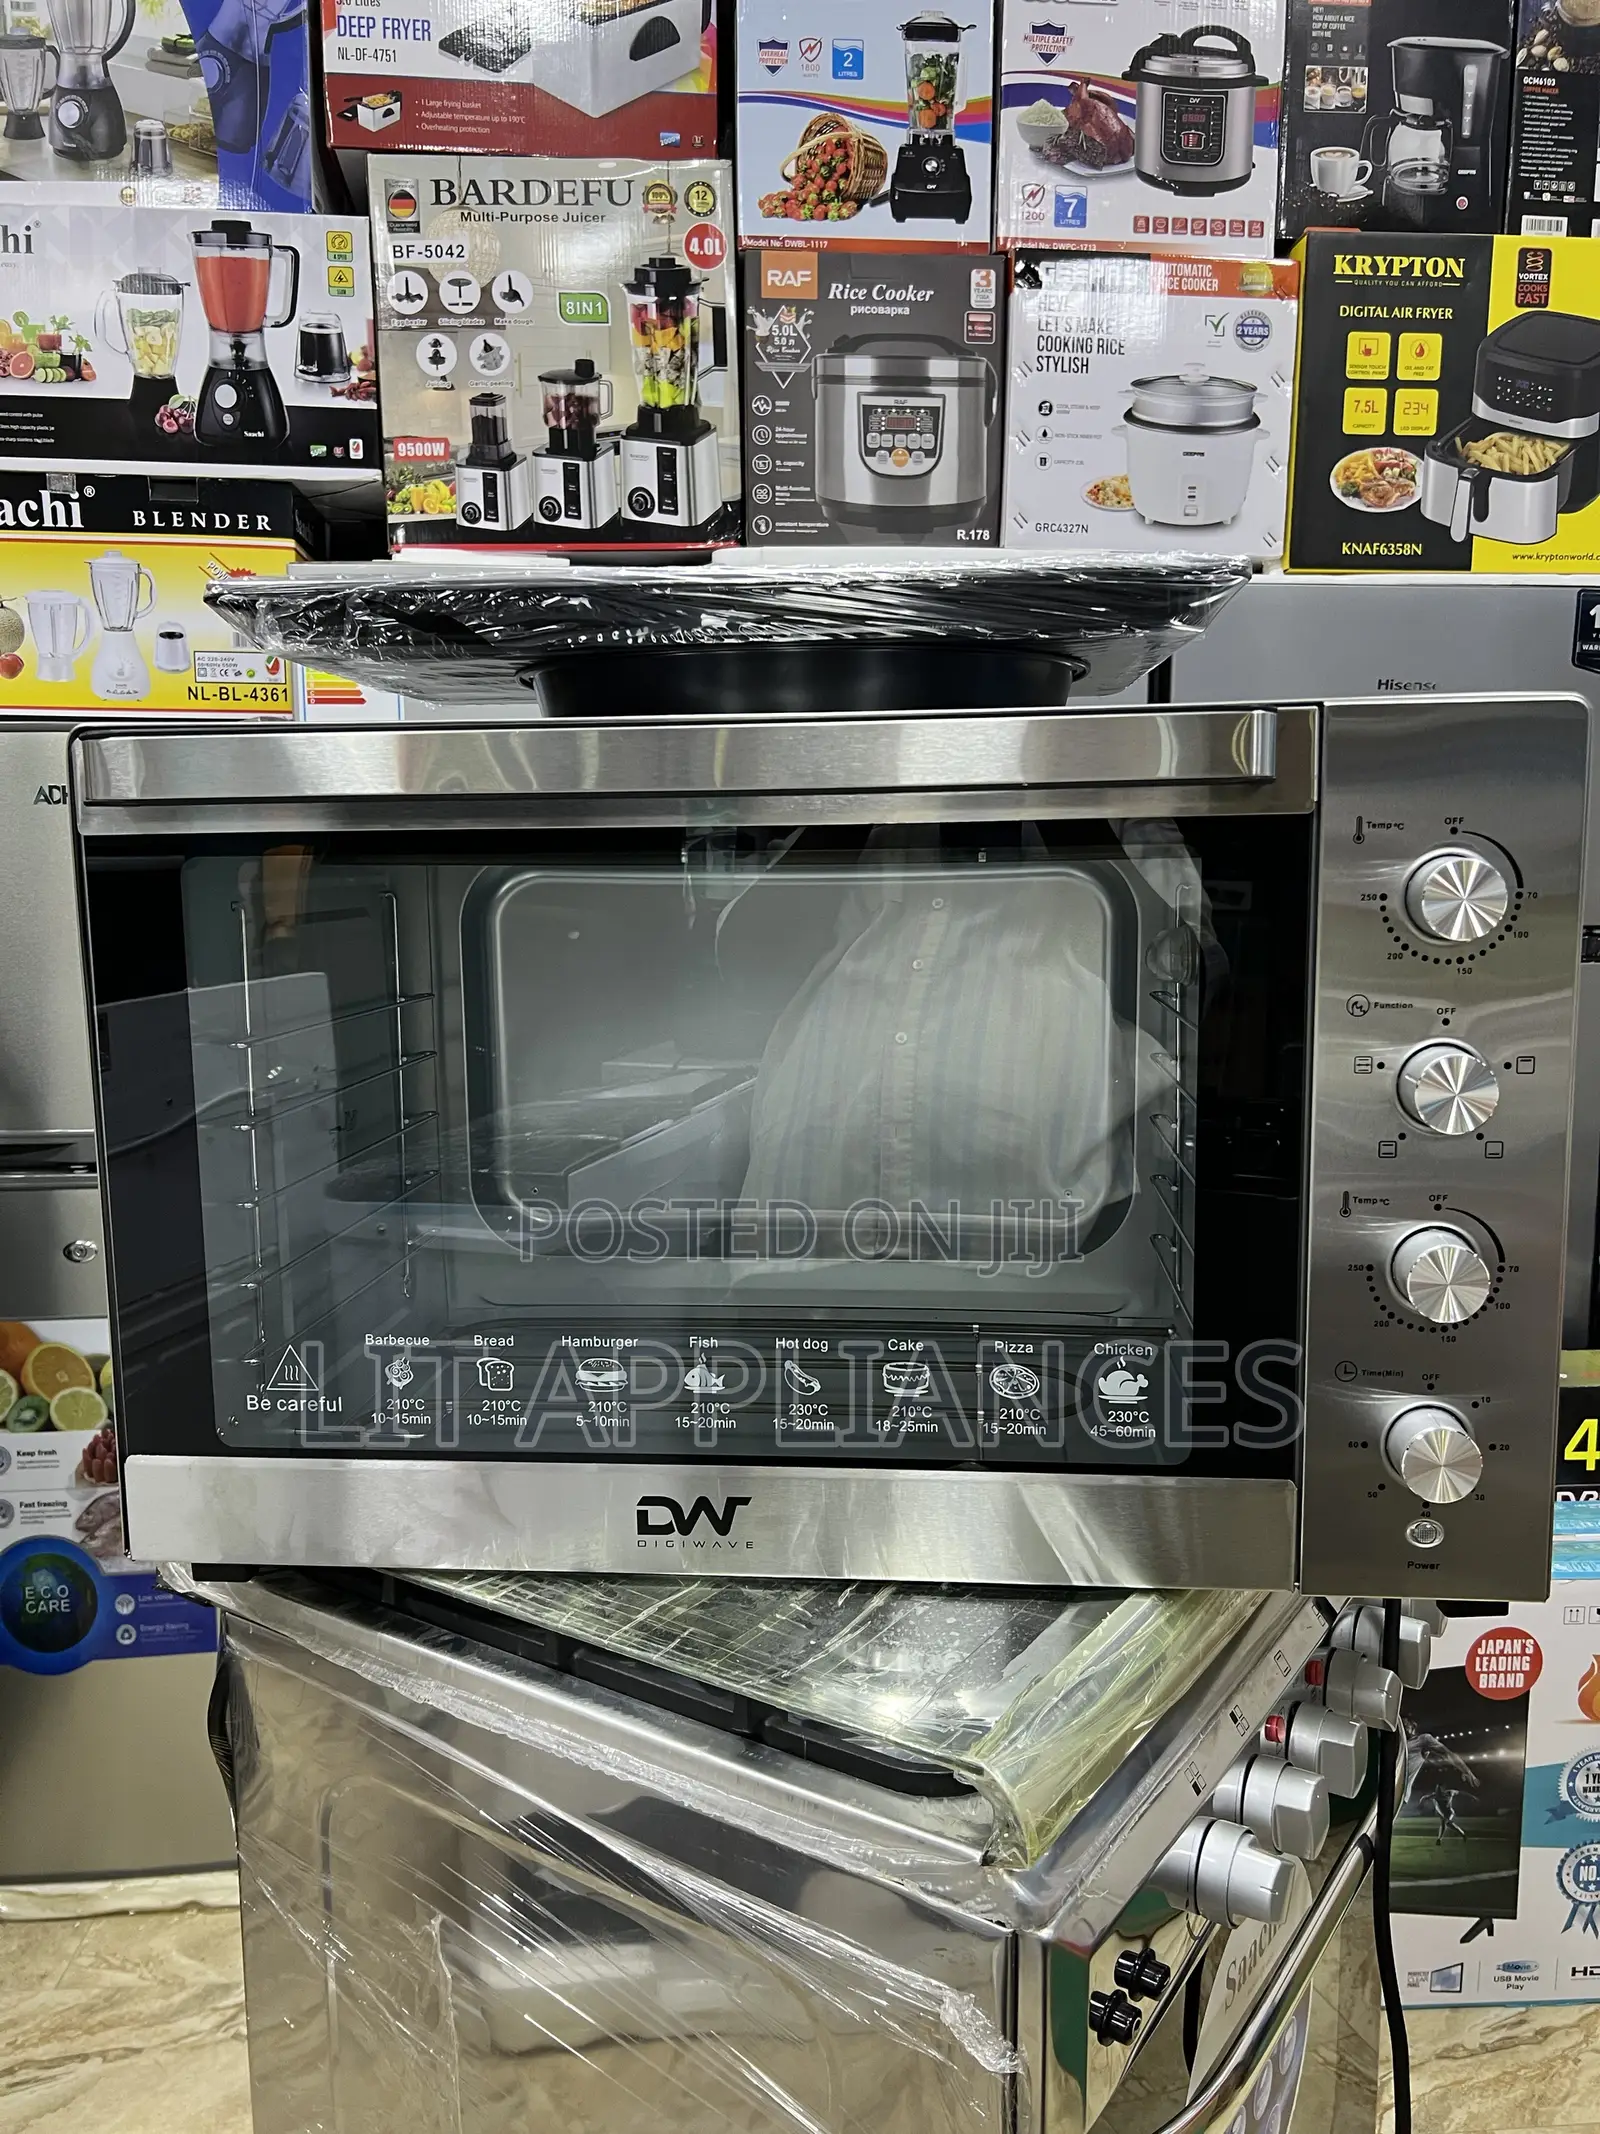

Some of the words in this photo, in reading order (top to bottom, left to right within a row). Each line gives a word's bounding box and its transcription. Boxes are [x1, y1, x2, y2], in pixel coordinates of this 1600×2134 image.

[336, 15, 376, 38] DEEP
[382, 17, 431, 41] FRYER
[1024, 34, 1051, 44] MULTIPLE
[1051, 36, 1073, 45] SAFETY
[338, 47, 396, 62] NL-DF-4751
[1031, 43, 1067, 53] PROTECTION
[843, 52, 853, 67] 2
[801, 64, 820, 72] 1800
[425, 99, 442, 108] Large
[443, 100, 461, 110] frying
[462, 101, 481, 109] basket
[421, 111, 453, 120] Adjustable
[454, 113, 491, 122] temperature
[421, 123, 459, 133] Overheating
[459, 126, 490, 134] protection
[430, 178, 635, 207] BARDEFU
[695, 191, 707, 201] 12
[1064, 198, 1077, 218] 7
[460, 211, 559, 225] Multi-Purpose
[562, 212, 606, 223] Juicer
[1021, 211, 1045, 221] 1200
[0, 224, 34, 254] hi
[747, 239, 769, 247] Model
[770, 239, 783, 248] No:
[785, 240, 828, 249] DWBL-1117
[393, 245, 465, 259] BF-5042
[689, 237, 723, 256] 4.0L
[1052, 243, 1097, 251] DWPC-1713
[1333, 254, 1465, 278] KRYPTON
[767, 269, 812, 287] RAF
[1519, 273, 1548, 281] VORTEX
[1181, 278, 1219, 292] COOKER
[1518, 284, 1548, 293] COOKS
[828, 283, 868, 300] Rice
[872, 284, 934, 302] Cooker
[1517, 293, 1548, 305] FAST
[565, 300, 603, 316] 8IN1
[850, 305, 910, 317] рисоварка
[1339, 305, 1390, 318] DIGITAL
[1391, 307, 1413, 319] AIR
[1415, 307, 1453, 320] FRYER
[772, 325, 797, 336] 5.0L
[1037, 315, 1073, 332] LET'S
[1076, 317, 1114, 335] MAKE
[1237, 326, 1243, 335] 2
[1243, 326, 1269, 336] YEARS
[774, 337, 787, 346] 5.0
[1037, 335, 1093, 354] COOKING
[1096, 338, 1126, 355] RICE
[1036, 355, 1089, 374] STYLISH
[1354, 399, 1379, 414] 7.5L
[1403, 401, 1429, 416] 234
[397, 441, 445, 457] 9500W
[0, 490, 84, 529] achi
[133, 510, 272, 531] BLENDER
[1035, 522, 1089, 534] GRC4327N
[956, 530, 990, 541] R.178
[1341, 543, 1423, 556] KNAF6358N
[187, 686, 288, 702] NL-BL-4361
[1444, 817, 1464, 825] OFF
[1360, 893, 1378, 902] 250
[1527, 891, 1538, 900] 70
[1513, 931, 1529, 939] 100
[1386, 952, 1404, 961] 200
[1456, 967, 1473, 976] 150
[1373, 1001, 1414, 1010] Function
[1436, 1007, 1457, 1016] OFF
[1428, 1194, 1448, 1202] OFF
[1348, 1264, 1364, 1272] 250
[1508, 1265, 1520, 1274] 70
[1495, 1302, 1511, 1310] 100
[1373, 1320, 1390, 1328] 200
[364, 1333, 430, 1347] Barbecue
[474, 1334, 515, 1347] Bread
[561, 1336, 639, 1349] Hamburger
[689, 1337, 719, 1349] Fish
[775, 1338, 800, 1350] Hot
[802, 1338, 829, 1352] dog
[887, 1338, 925, 1352] Cake
[1441, 1335, 1457, 1344] 150
[994, 1340, 1034, 1354] Pizza
[1093, 1341, 1154, 1357] Chicken
[1361, 1369, 1404, 1378] Time(Min)
[1421, 1373, 1441, 1381] OFF
[246, 1394, 263, 1411] Be
[276, 1395, 343, 1412] careful
[386, 1398, 425, 1411] 210°C
[482, 1400, 522, 1412] 210°C
[588, 1401, 628, 1413] 210°C
[691, 1402, 731, 1414] 210°C
[788, 1404, 829, 1416] 230°C
[892, 1405, 933, 1418] 210°C
[1000, 1407, 1041, 1421] 210°C
[1107, 1410, 1150, 1423] 230°C
[371, 1413, 431, 1426] 10~15min
[467, 1414, 528, 1427] 10~15min
[576, 1416, 630, 1428] 5~10min
[674, 1417, 737, 1430] 15~20min
[772, 1418, 835, 1431] 15~20min
[875, 1420, 939, 1434] 18~25min
[983, 1421, 1047, 1436] 15~20min
[1090, 1424, 1157, 1439] 45~60min
[1348, 1441, 1359, 1449] 60
[1499, 1443, 1510, 1451] 20
[1563, 1418, 1600, 1471] 4
[1367, 1491, 1378, 1499] 50
[20, 1501, 36, 1509] Fast
[37, 1500, 68, 1508] freezing
[637, 1540, 754, 1549] DIGIWAVE
[1407, 1561, 1441, 1571] Power
[25, 1584, 69, 1599] ECO
[25, 1599, 71, 1615] CARE
[1477, 1638, 1535, 1655] JAPAN'S
[1475, 1656, 1531, 1672] LEADING
[1479, 1673, 1525, 1689] BRAND
[1575, 1754, 1594, 1771] YEAR
[1579, 1865, 1600, 1882] NO.
[1493, 1975, 1512, 1983] USB
[1514, 1975, 1540, 1983] Movie
[1506, 1983, 1525, 1991] Play
